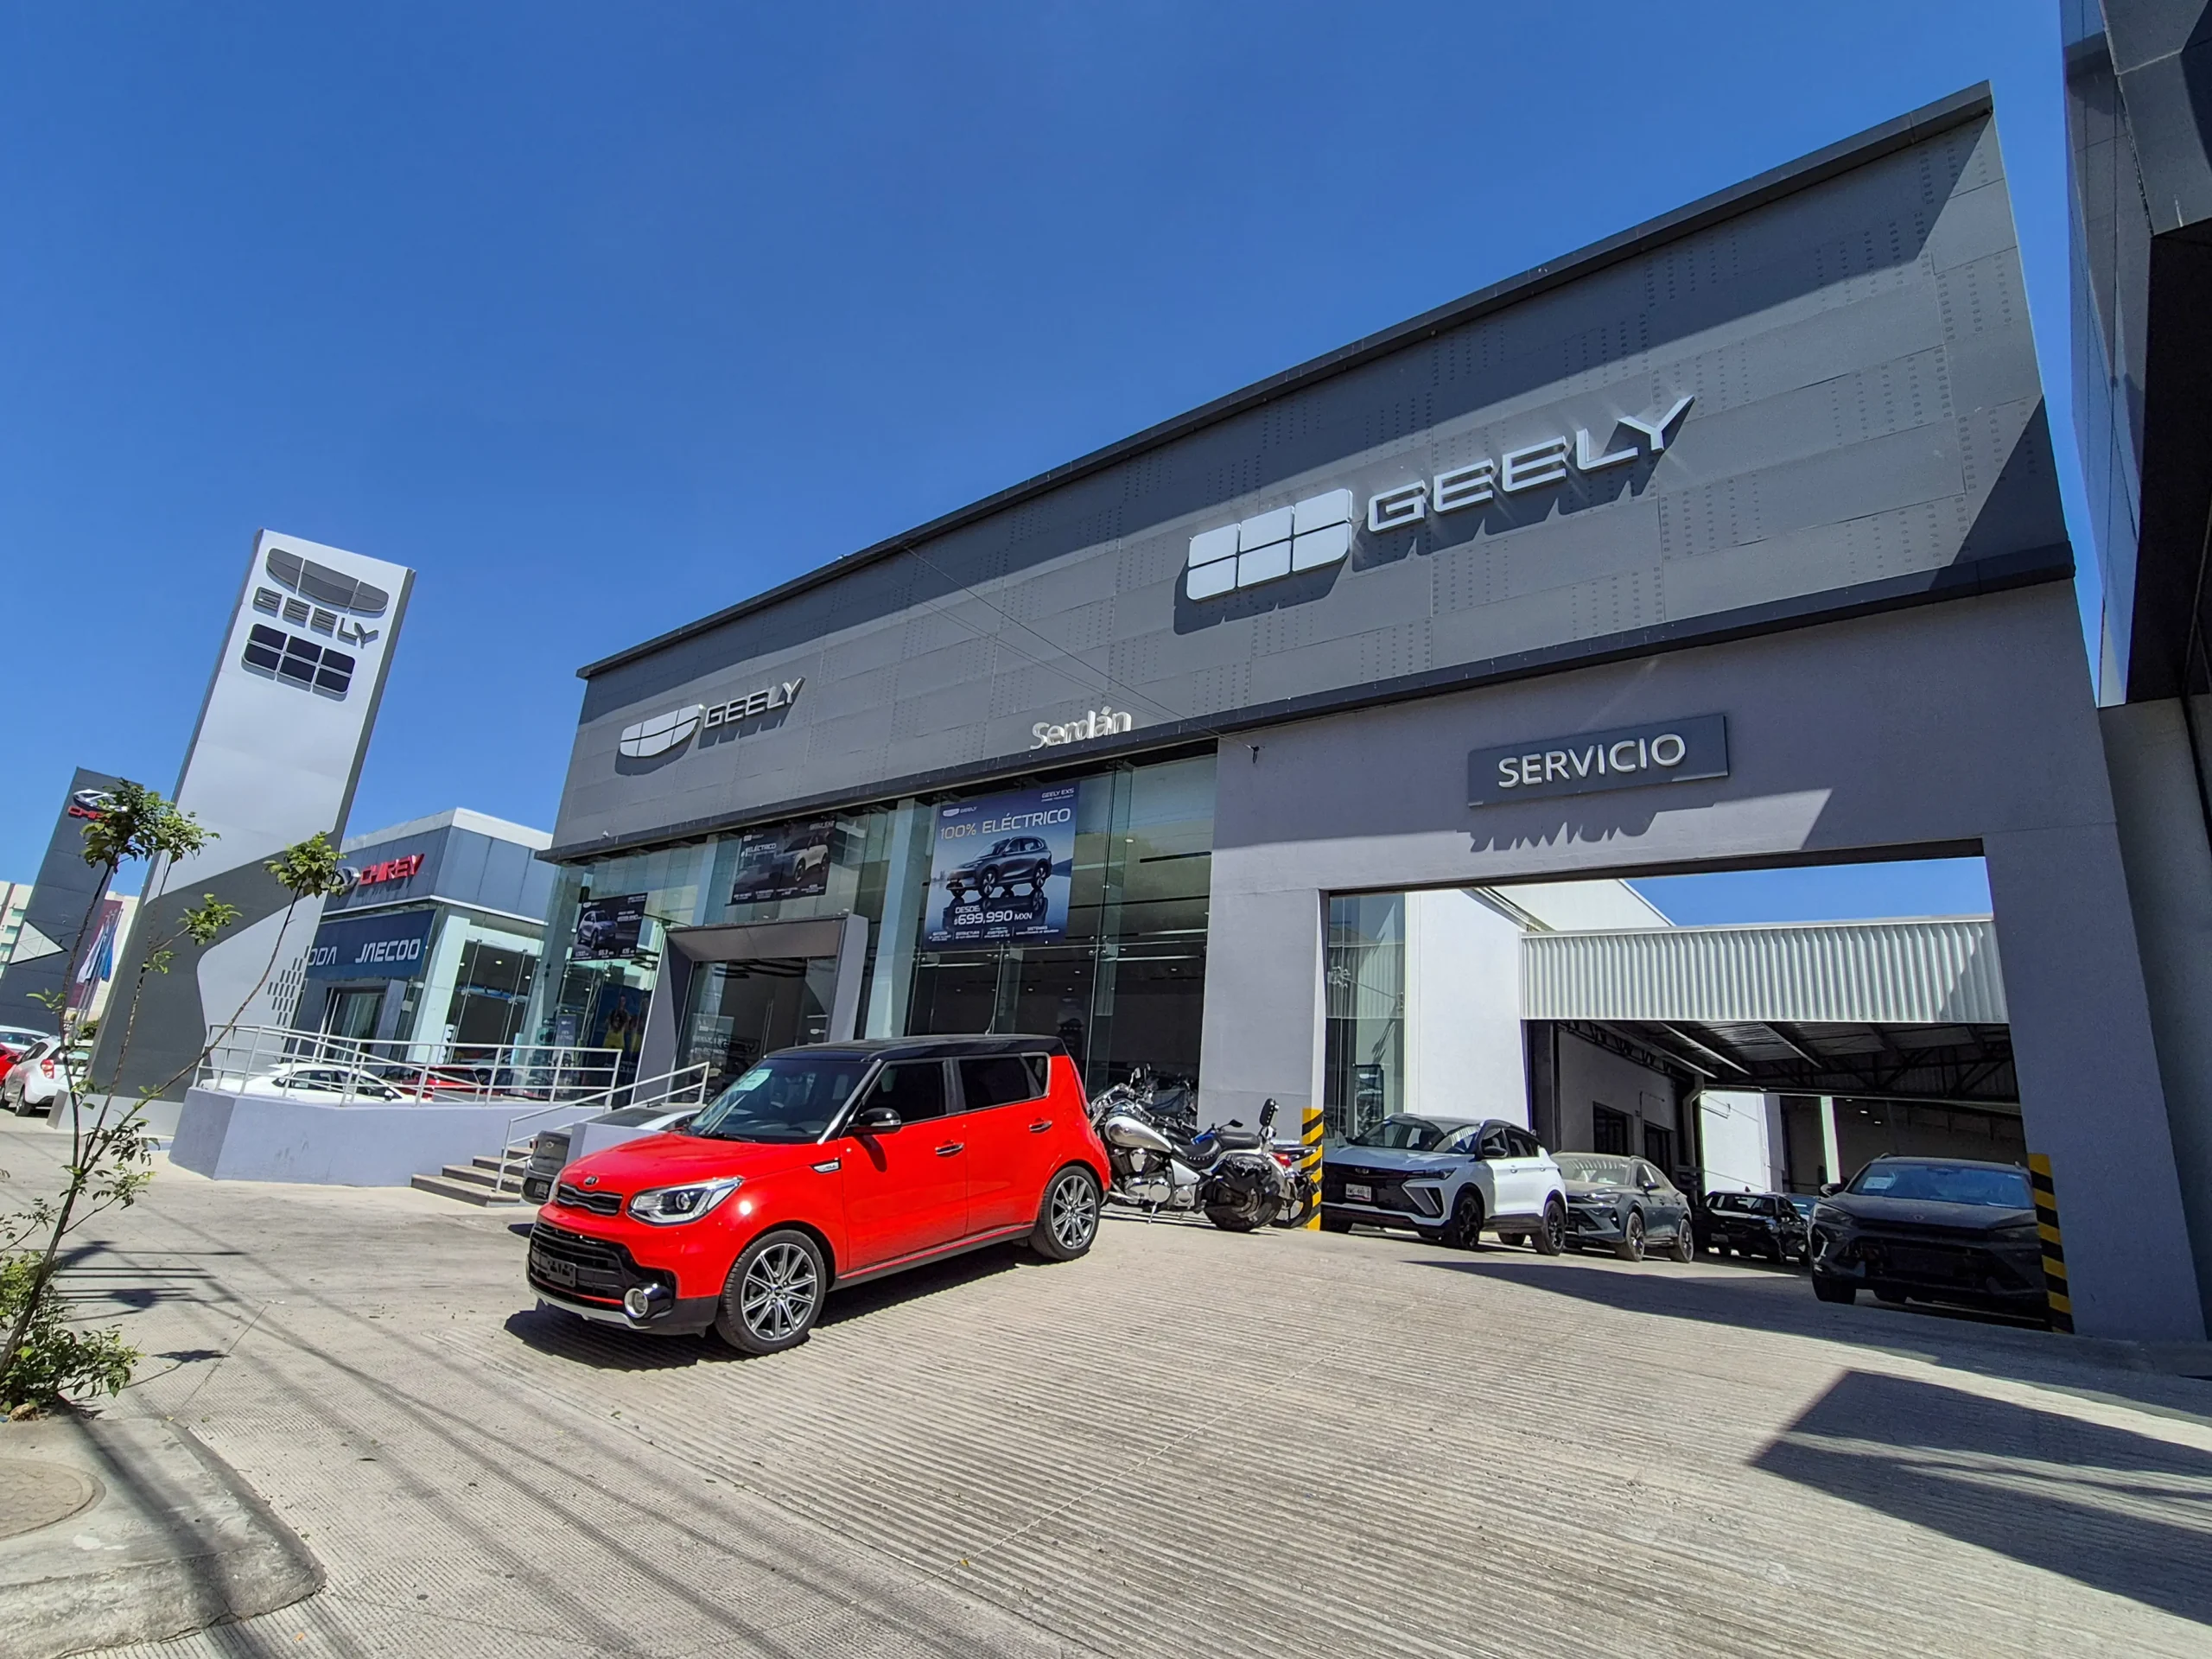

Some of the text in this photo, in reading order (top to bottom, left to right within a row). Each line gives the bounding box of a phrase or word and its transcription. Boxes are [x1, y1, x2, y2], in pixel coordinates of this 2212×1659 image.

[1368, 395, 1695, 532] GEELY
[252, 586, 379, 650] GEELY
[704, 677, 805, 728] GEELY
[1030, 705, 1132, 750] Serdán
[1498, 734, 1687, 788] SERVICIO
[941, 808, 1071, 840] 100% ELÉCTRICO
[359, 854, 425, 886] CHIREY
[953, 910, 1033, 925] $699,990 MXN
[955, 905, 981, 914] DESDE
[354, 938, 421, 963] JAECOO
